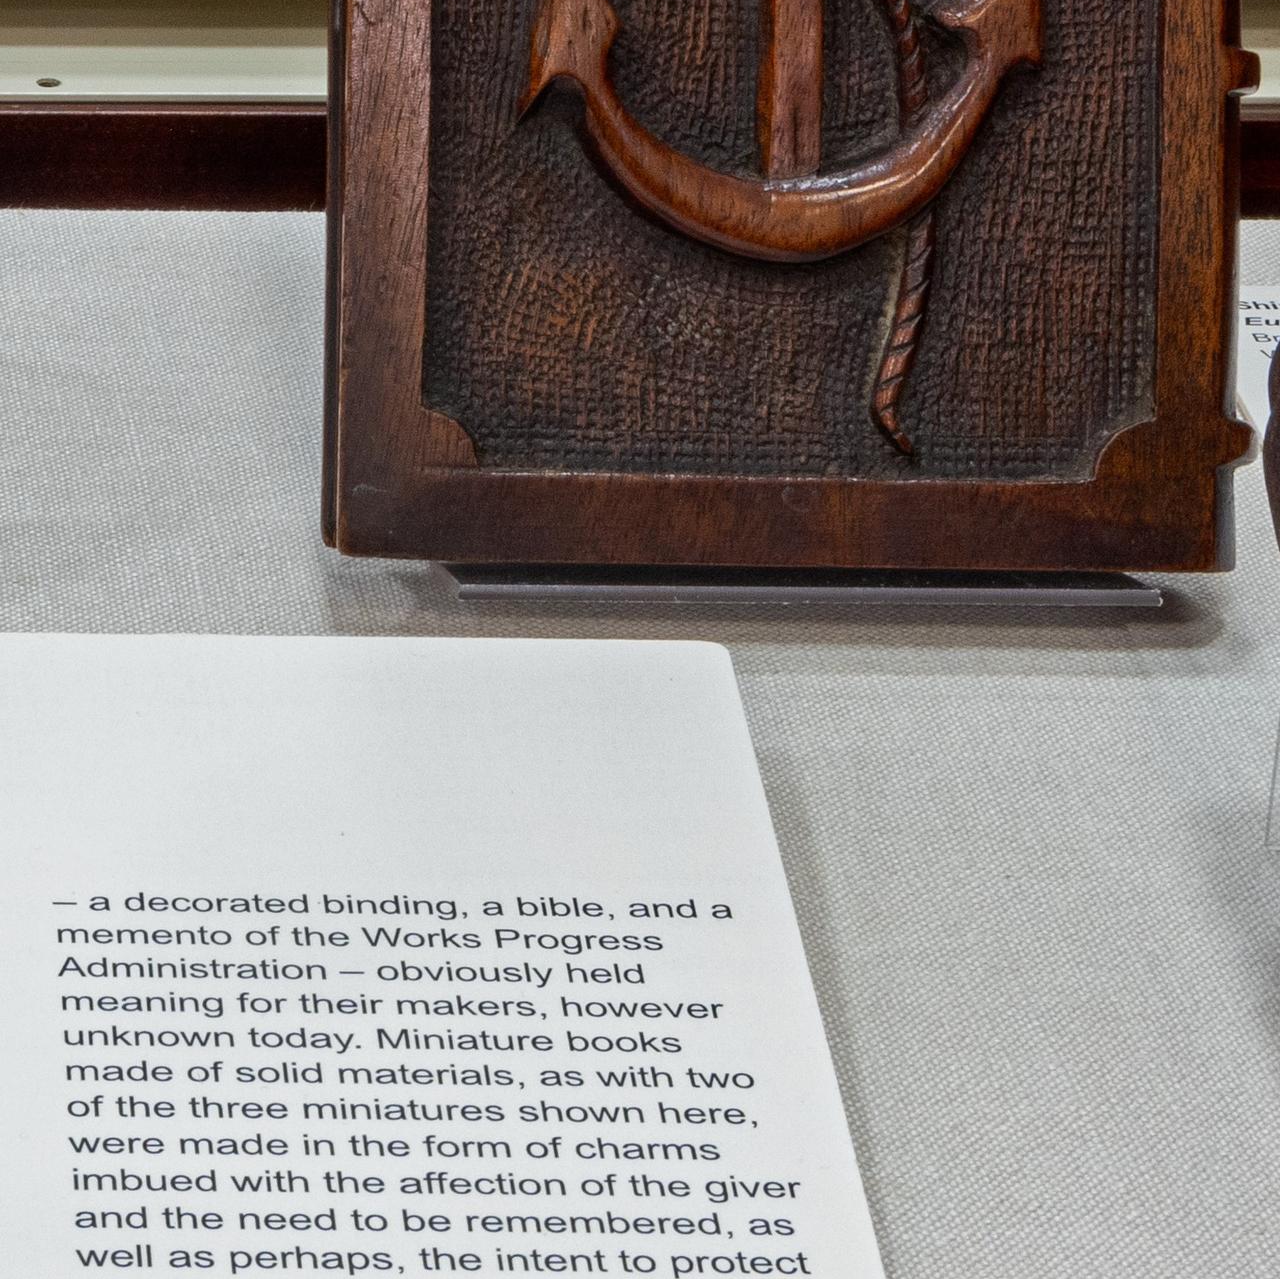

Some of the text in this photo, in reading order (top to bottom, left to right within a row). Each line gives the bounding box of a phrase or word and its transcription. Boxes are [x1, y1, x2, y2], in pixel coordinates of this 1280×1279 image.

[89, 896, 111, 912] a
[124, 891, 310, 914] decorated
[322, 893, 468, 921] binding,
[482, 900, 505, 917] a
[516, 896, 615, 921] bible,
[628, 898, 698, 919] and
[711, 903, 733, 920] a
[57, 925, 664, 956] memento of the Works Progress
